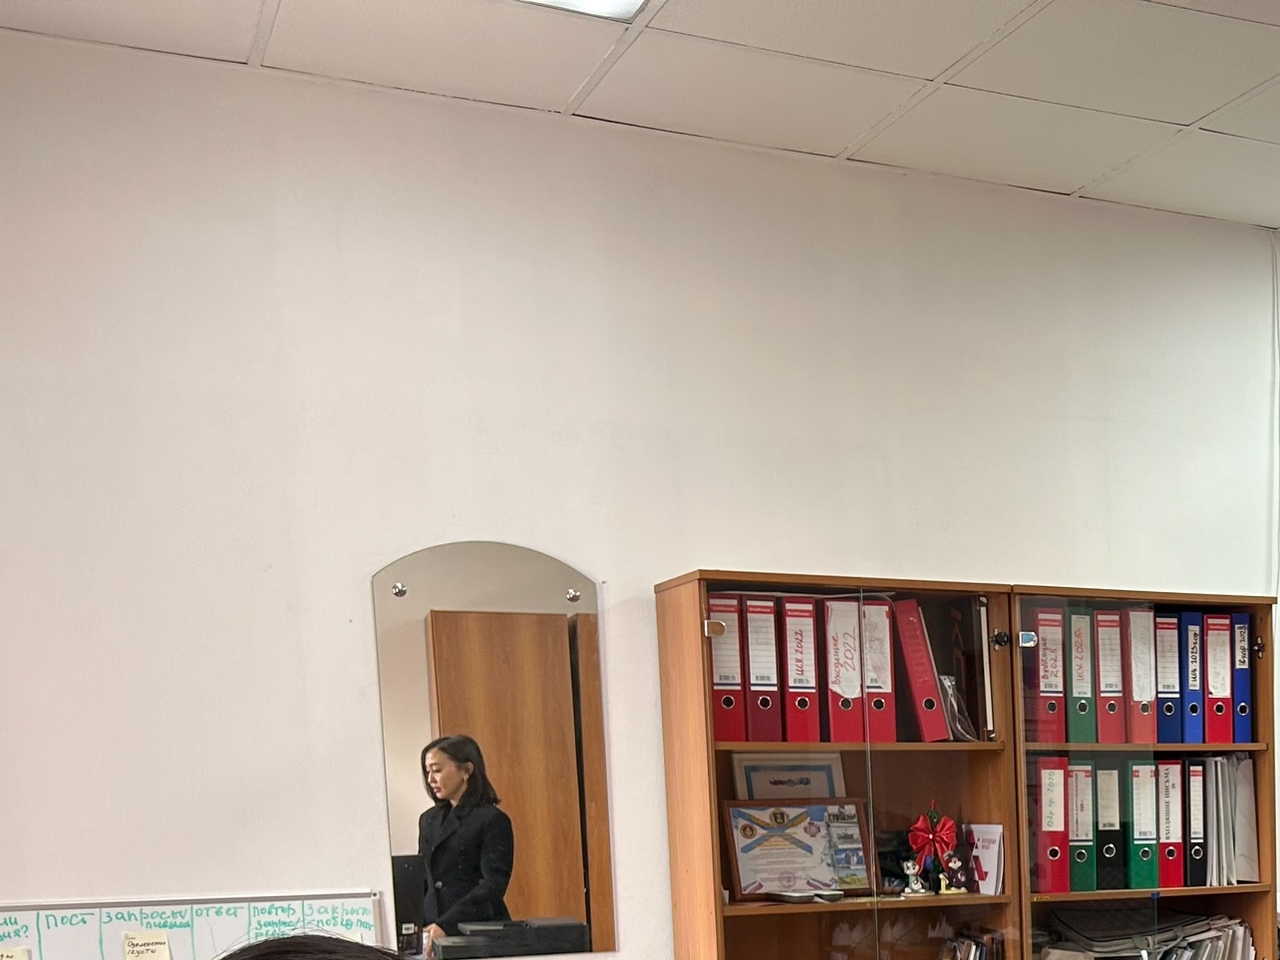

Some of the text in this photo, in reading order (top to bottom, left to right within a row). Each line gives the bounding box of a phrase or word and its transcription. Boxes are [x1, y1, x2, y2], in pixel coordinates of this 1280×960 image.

[794, 629, 804, 655] 2022
[843, 626, 857, 672] 2022
[195, 905, 245, 917] ответ
